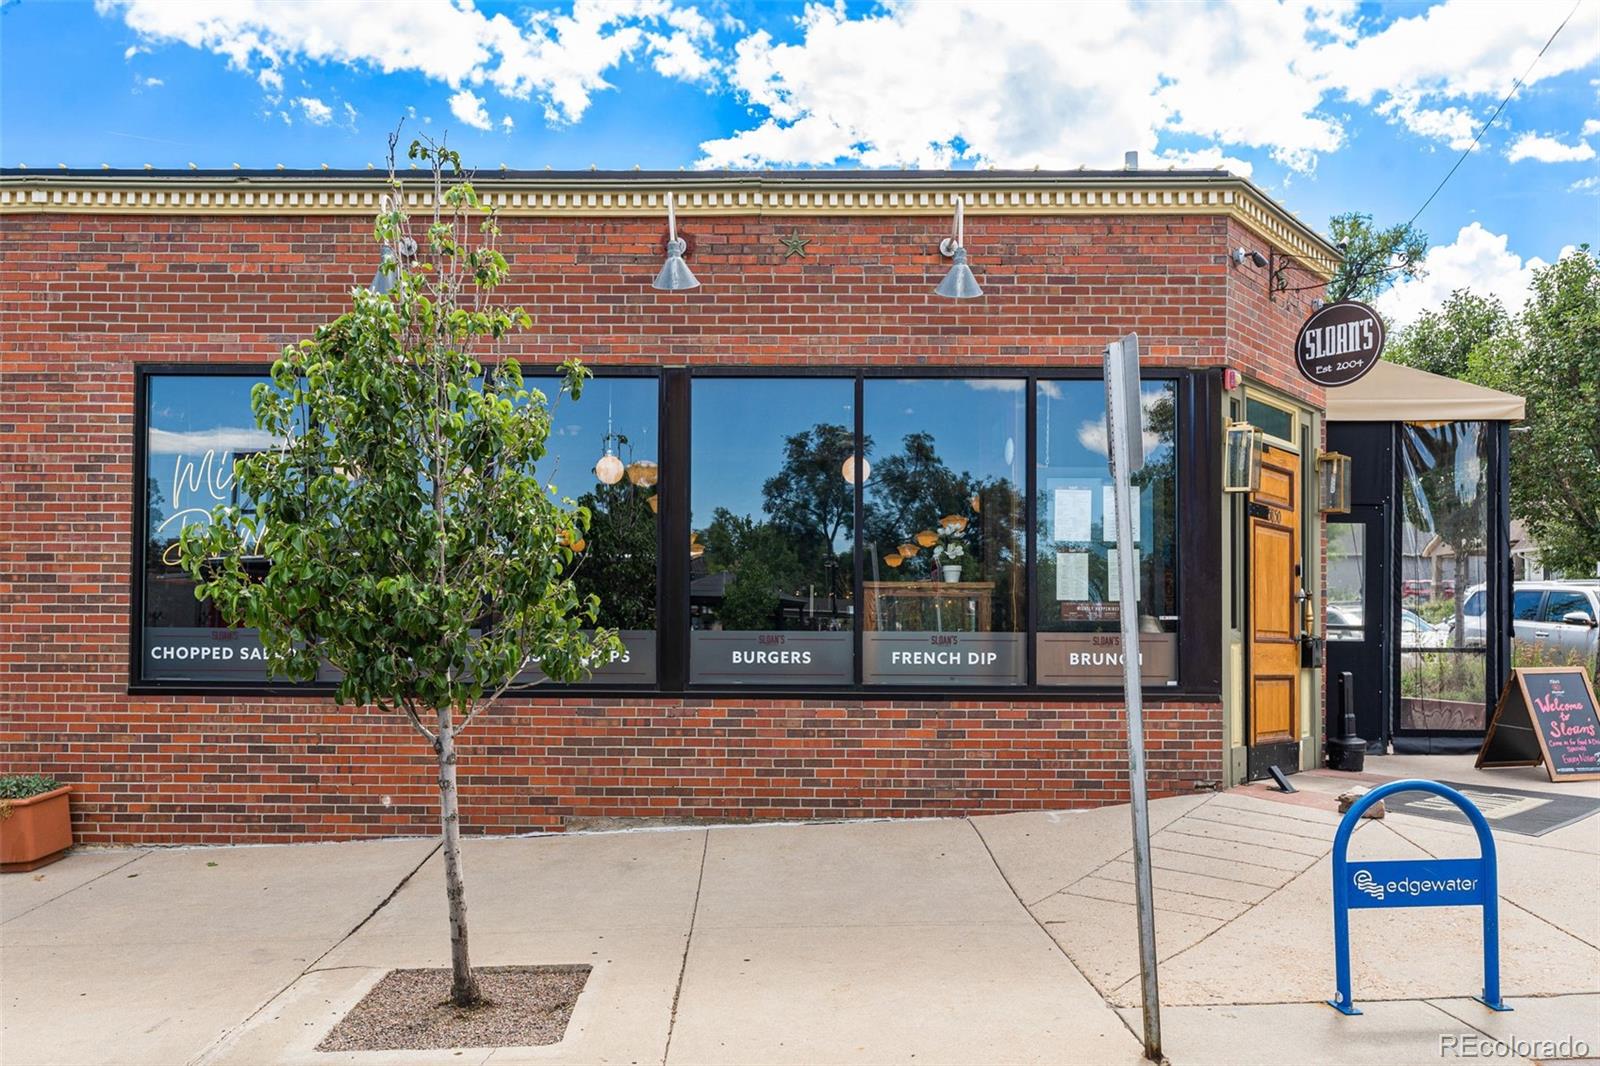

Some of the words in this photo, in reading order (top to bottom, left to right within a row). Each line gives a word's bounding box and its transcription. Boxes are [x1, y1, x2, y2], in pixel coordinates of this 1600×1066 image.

[1305, 318, 1373, 360] SLOAN'S
[1315, 364, 1332, 374] Est
[1336, 359, 1364, 371] 2004
[931, 635, 958, 646] SLOAN'S
[1092, 636, 1119, 646] SLOAN'S
[151, 646, 234, 660] CHOPPED
[732, 651, 811, 664] BURGERS
[892, 652, 961, 665] FRENCH
[968, 653, 997, 665] DIP
[1070, 653, 1143, 666] BRUN
[1535, 694, 1583, 713] Welcome
[1560, 711, 1570, 721] to
[1386, 877, 1478, 895] edgewater
